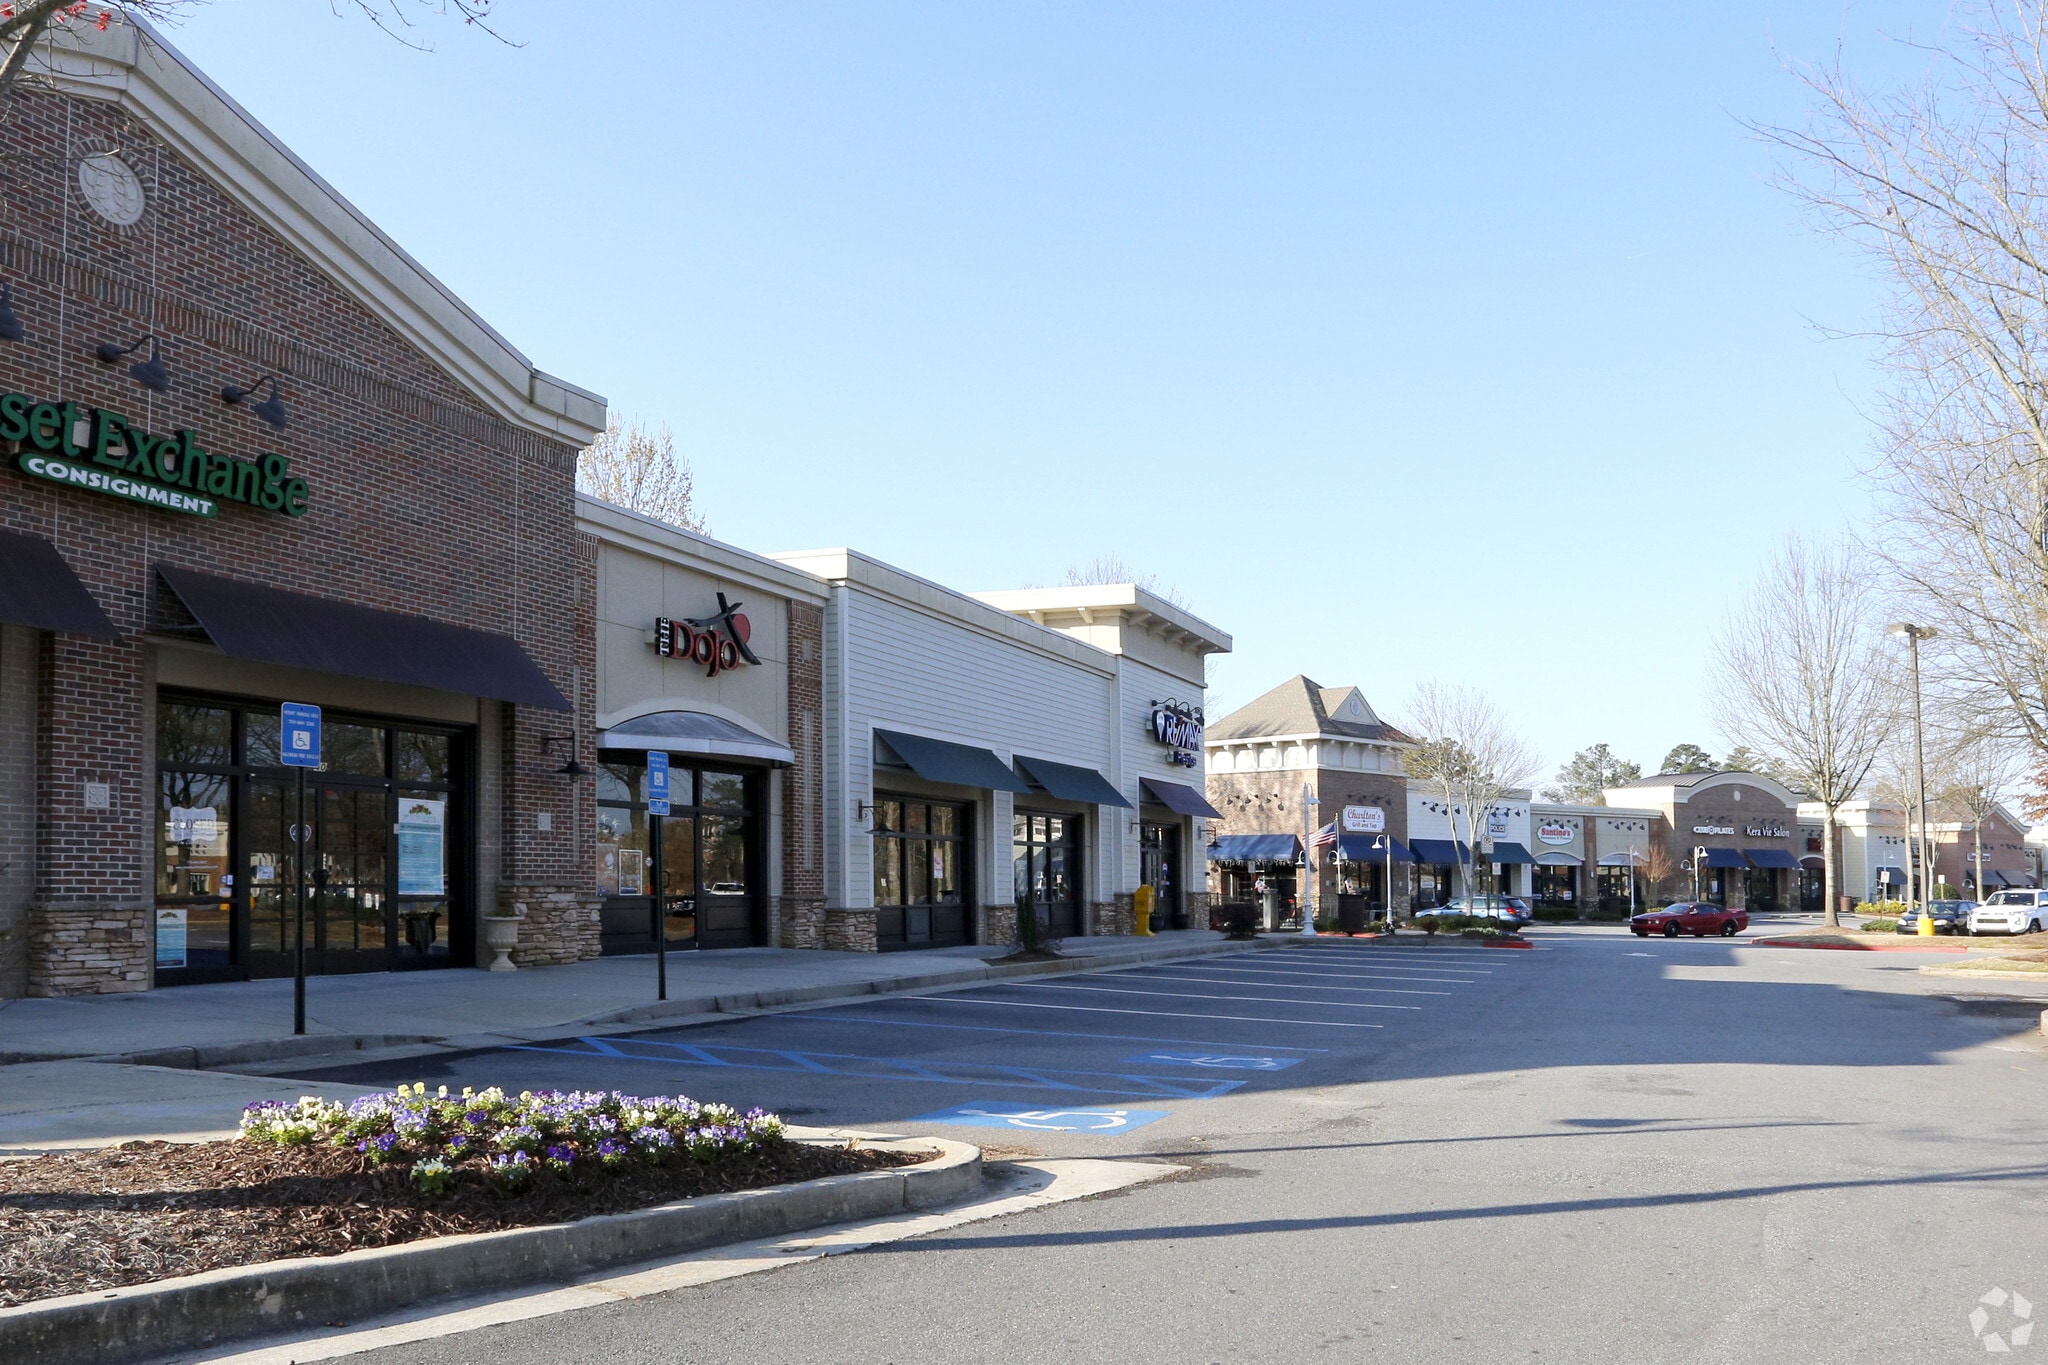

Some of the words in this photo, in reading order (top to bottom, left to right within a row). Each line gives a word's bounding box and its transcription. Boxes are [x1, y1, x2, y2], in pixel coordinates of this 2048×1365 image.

[92, 408, 309, 518] Exchange
[27, 457, 213, 515] CONSIGNMENT
[660, 616, 670, 657] THE
[1347, 809, 1381, 821] Charlton's
[1491, 824, 1506, 832] POLICE
[1541, 828, 1571, 837] Santino's
[1714, 827, 1735, 835] PILATES
[1746, 825, 1761, 837] Kera
[1762, 826, 1772, 837] Vie
[1774, 826, 1790, 838] Salon
